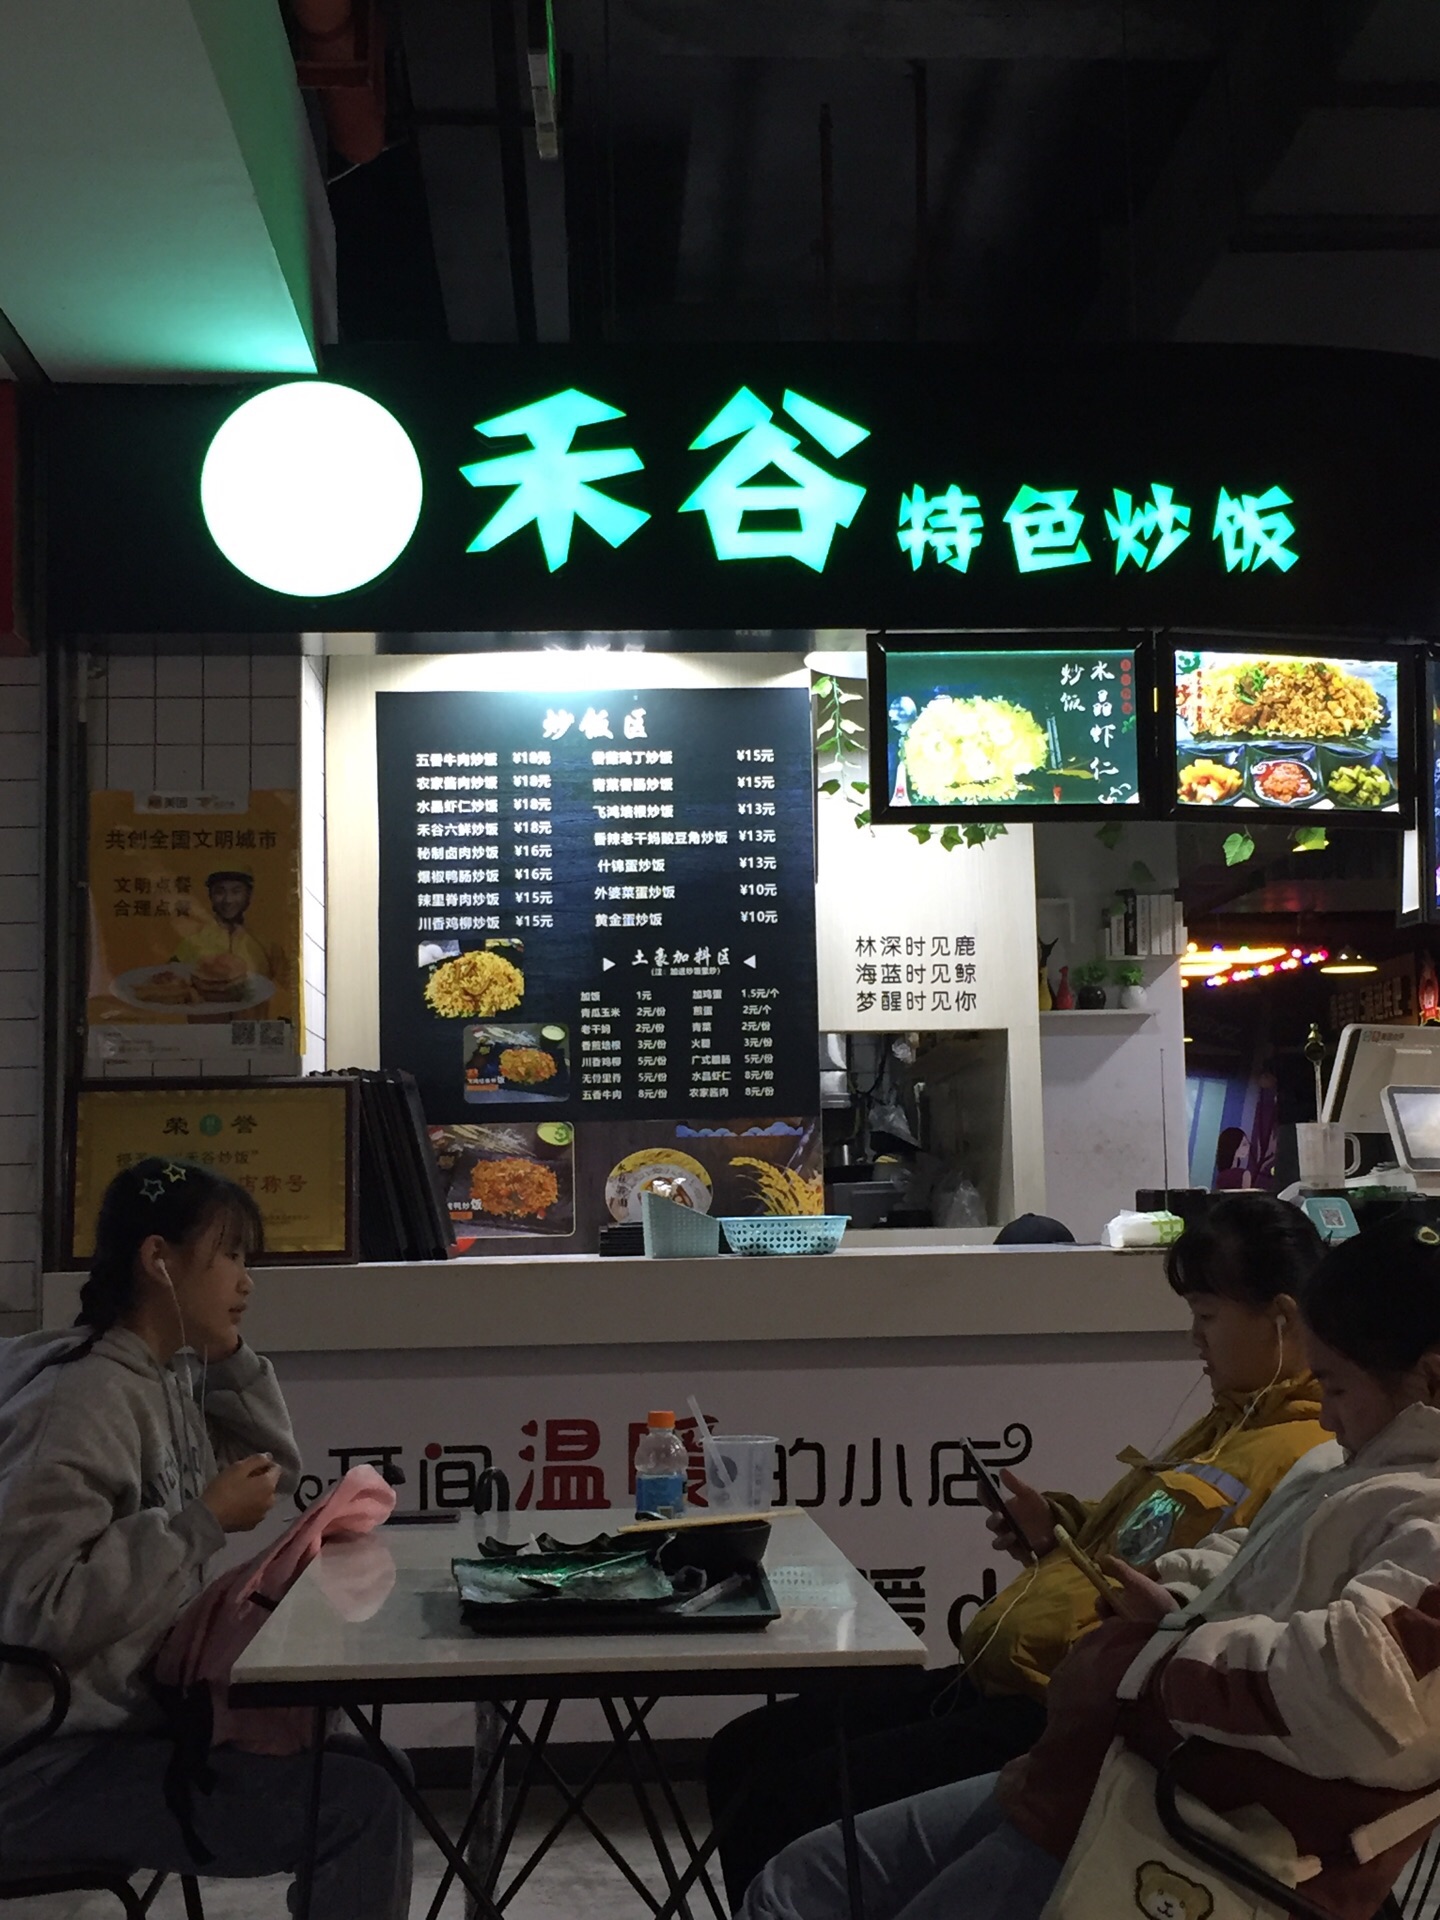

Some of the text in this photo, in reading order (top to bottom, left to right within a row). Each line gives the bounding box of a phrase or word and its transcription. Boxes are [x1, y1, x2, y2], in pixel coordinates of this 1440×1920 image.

[459, 384, 1301, 575] 禾谷 特色炒饭
[1060, 663, 1086, 712] 炒饭
[543, 707, 648, 740] 炒饭区
[1090, 660, 1119, 780] 水晶虾仁
[416, 752, 497, 767] 五香牛肉炒饭
[737, 749, 774, 762] ¥15元
[738, 776, 774, 789] ¥15元
[417, 798, 551, 813] 水晶虾仁炒饭 ¥18元
[738, 803, 775, 816] ¥13元
[514, 821, 552, 834] ¥18元
[106, 829, 277, 850] 共创全国文明城市
[739, 830, 776, 842] ¥13元
[417, 845, 552, 860] 秘制卤肉炒饭 ¥16元
[598, 857, 776, 872] 什锦蛋炒饭 ¥13元
[515, 868, 552, 880] ¥16元
[114, 876, 191, 894] 文明点餐
[595, 884, 777, 899] 外婆菜蛋炒饭 ¥10元
[515, 891, 553, 904] ¥15元
[114, 900, 191, 917] 合理点餐
[419, 915, 553, 930] 川香鸡柳炒饭 ¥15元
[595, 911, 777, 927] 黄金蛋炒饭 ¥10元
[855, 936, 976, 957] 林深时见鹿
[632, 947, 731, 967] 土豪加料区
[856, 963, 977, 985] 海蓝时见鲸
[637, 991, 651, 1000] 1元
[742, 988, 779, 998] 1.5元/个
[856, 990, 977, 1012] 梦醒时见你
[637, 1007, 666, 1016] 2元/份
[743, 1005, 771, 1014] 2元/个
[636, 1024, 664, 1033] 2元/份
[742, 1022, 770, 1031] 2元/份
[638, 1040, 666, 1049] 3元/份
[745, 1038, 772, 1047] 3元/份
[638, 1056, 667, 1066] 5元/份
[745, 1054, 773, 1063] 5元/份
[639, 1073, 667, 1082] 5元/份
[692, 1071, 773, 1081] 水晶虾仁 8元/份
[582, 1089, 667, 1100] 五香牛肉 8元/份
[745, 1087, 774, 1096] 8元/份
